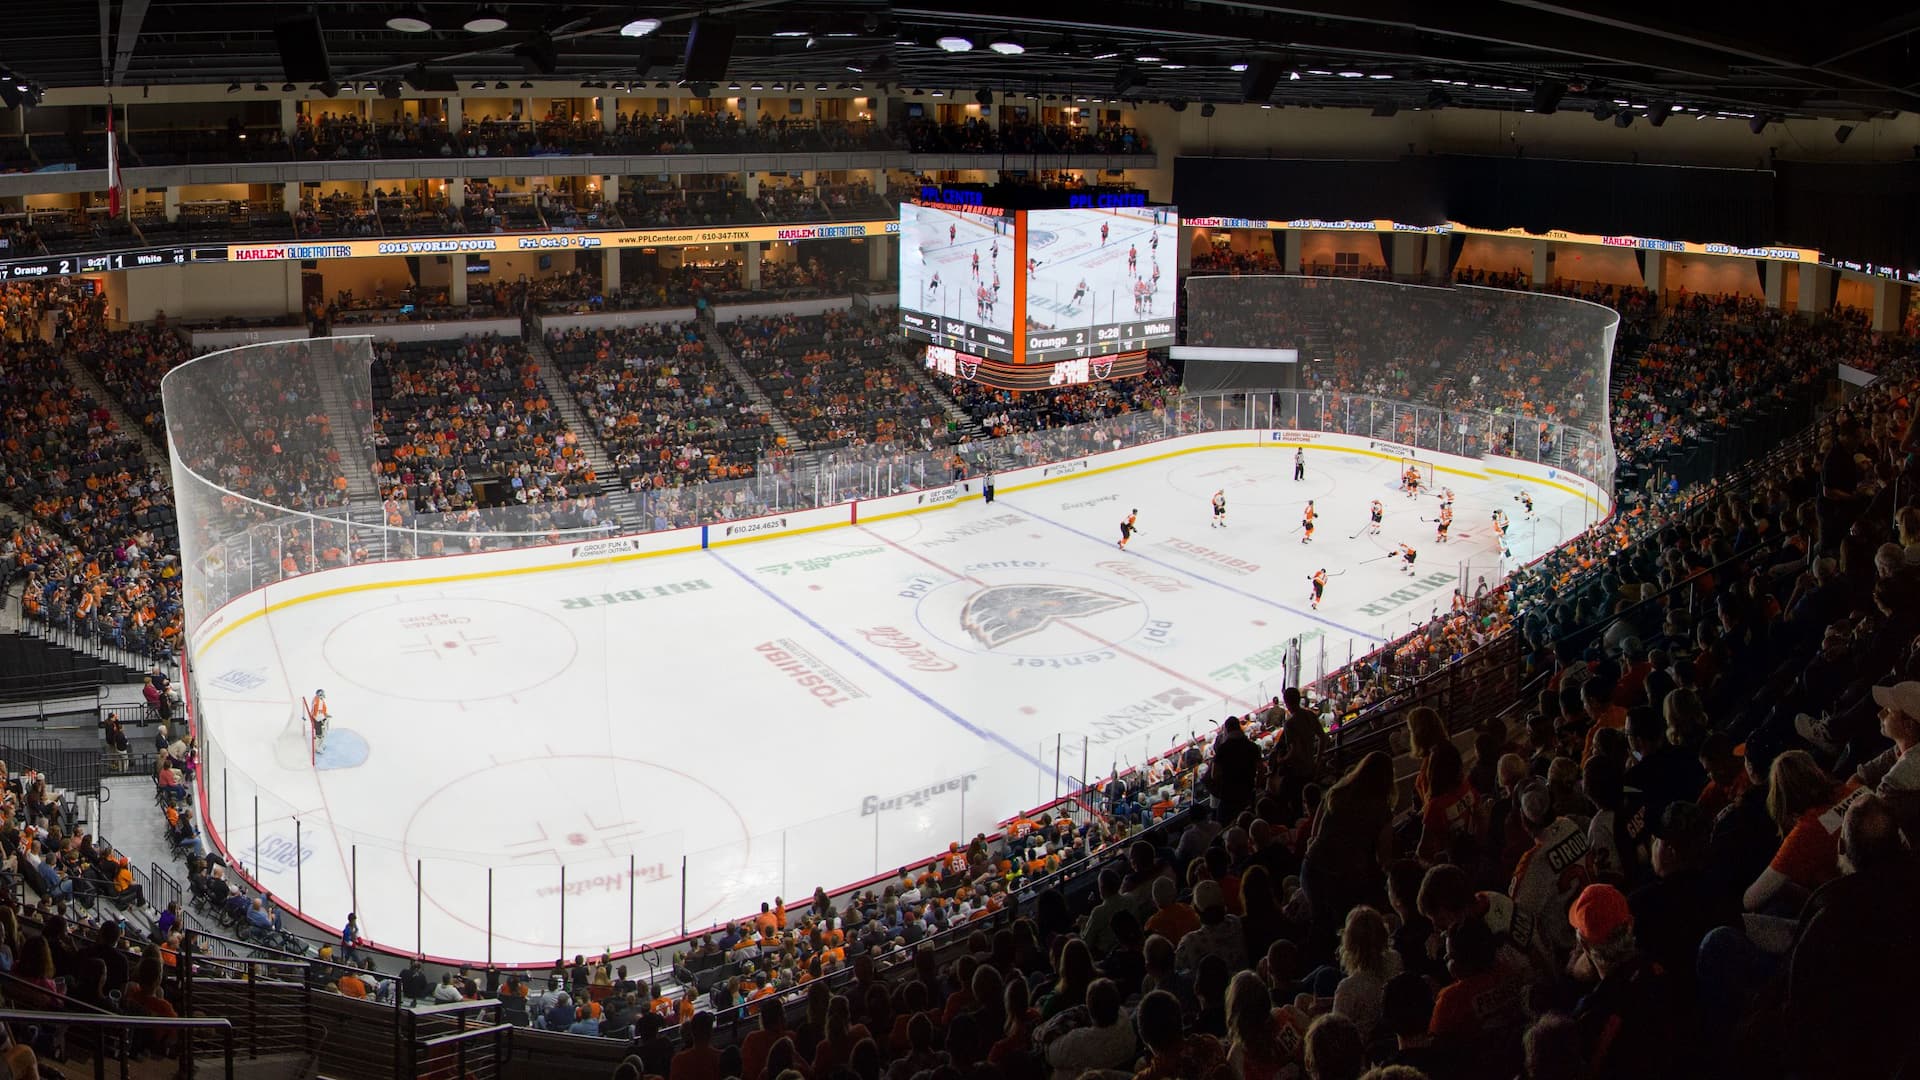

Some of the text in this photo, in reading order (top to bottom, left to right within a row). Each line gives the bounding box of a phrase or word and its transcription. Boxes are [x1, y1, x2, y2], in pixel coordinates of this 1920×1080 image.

[921, 186, 940, 201] PPL
[943, 189, 983, 205] CENTER
[1069, 192, 1145, 208] PPL CENTER
[961, 204, 1005, 217] PHANTOMS
[1184, 218, 1220, 227] HARLEM
[1288, 219, 1376, 230] 2015 WORLD TOUR
[778, 229, 815, 240] HARLEM
[817, 226, 866, 238] GLOBETROTTERS
[235, 248, 285, 260] HARLEM
[287, 246, 351, 259] GLOBETROTTERS
[378, 242, 408, 254] 2015
[410, 240, 459, 252] WORLD
[459, 239, 496, 250] TOUR
[518, 239, 538, 249] Fri.
[540, 238, 560, 248] Oct.
[560, 237, 568, 247] 3
[578, 236, 600, 248] 7pm
[618, 233, 693, 244] www.PPLCenter.com
[701, 231, 750, 241] 610-347-TIXX
[1602, 235, 1800, 260] HARLEM GLOBETROTTERS 2015 WORLD TOUR
[14, 264, 48, 276] Orange
[59, 260, 70, 275] 2
[87, 257, 107, 268] 9:27
[114, 255, 123, 269] 1
[137, 254, 162, 265] White
[173, 254, 184, 264] 15
[1845, 260, 1861, 271] Orange
[1866, 262, 1872, 274] 2
[1895, 268, 1900, 280] 1
[904, 314, 923, 326] Orange
[931, 319, 937, 330] 2
[970, 328, 975, 339] 1
[987, 334, 1005, 345] White
[1030, 323, 1170, 349] Orange 2 9:28 1 White
[927, 345, 956, 363] HOME
[1054, 358, 1090, 374] HOME
[1049, 369, 1090, 385] OF THE
[734, 520, 780, 534] 610.224.4625
[583, 542, 607, 552] GROUP
[608, 541, 622, 550] FUN
[608, 545, 631, 554] OUTINGS
[1166, 536, 1262, 573] TOSHIBA
[897, 559, 1050, 599] ppl center
[1010, 650, 1117, 669] center
[754, 640, 852, 709] TOSHIBA
[536, 872, 622, 898] Hortons
